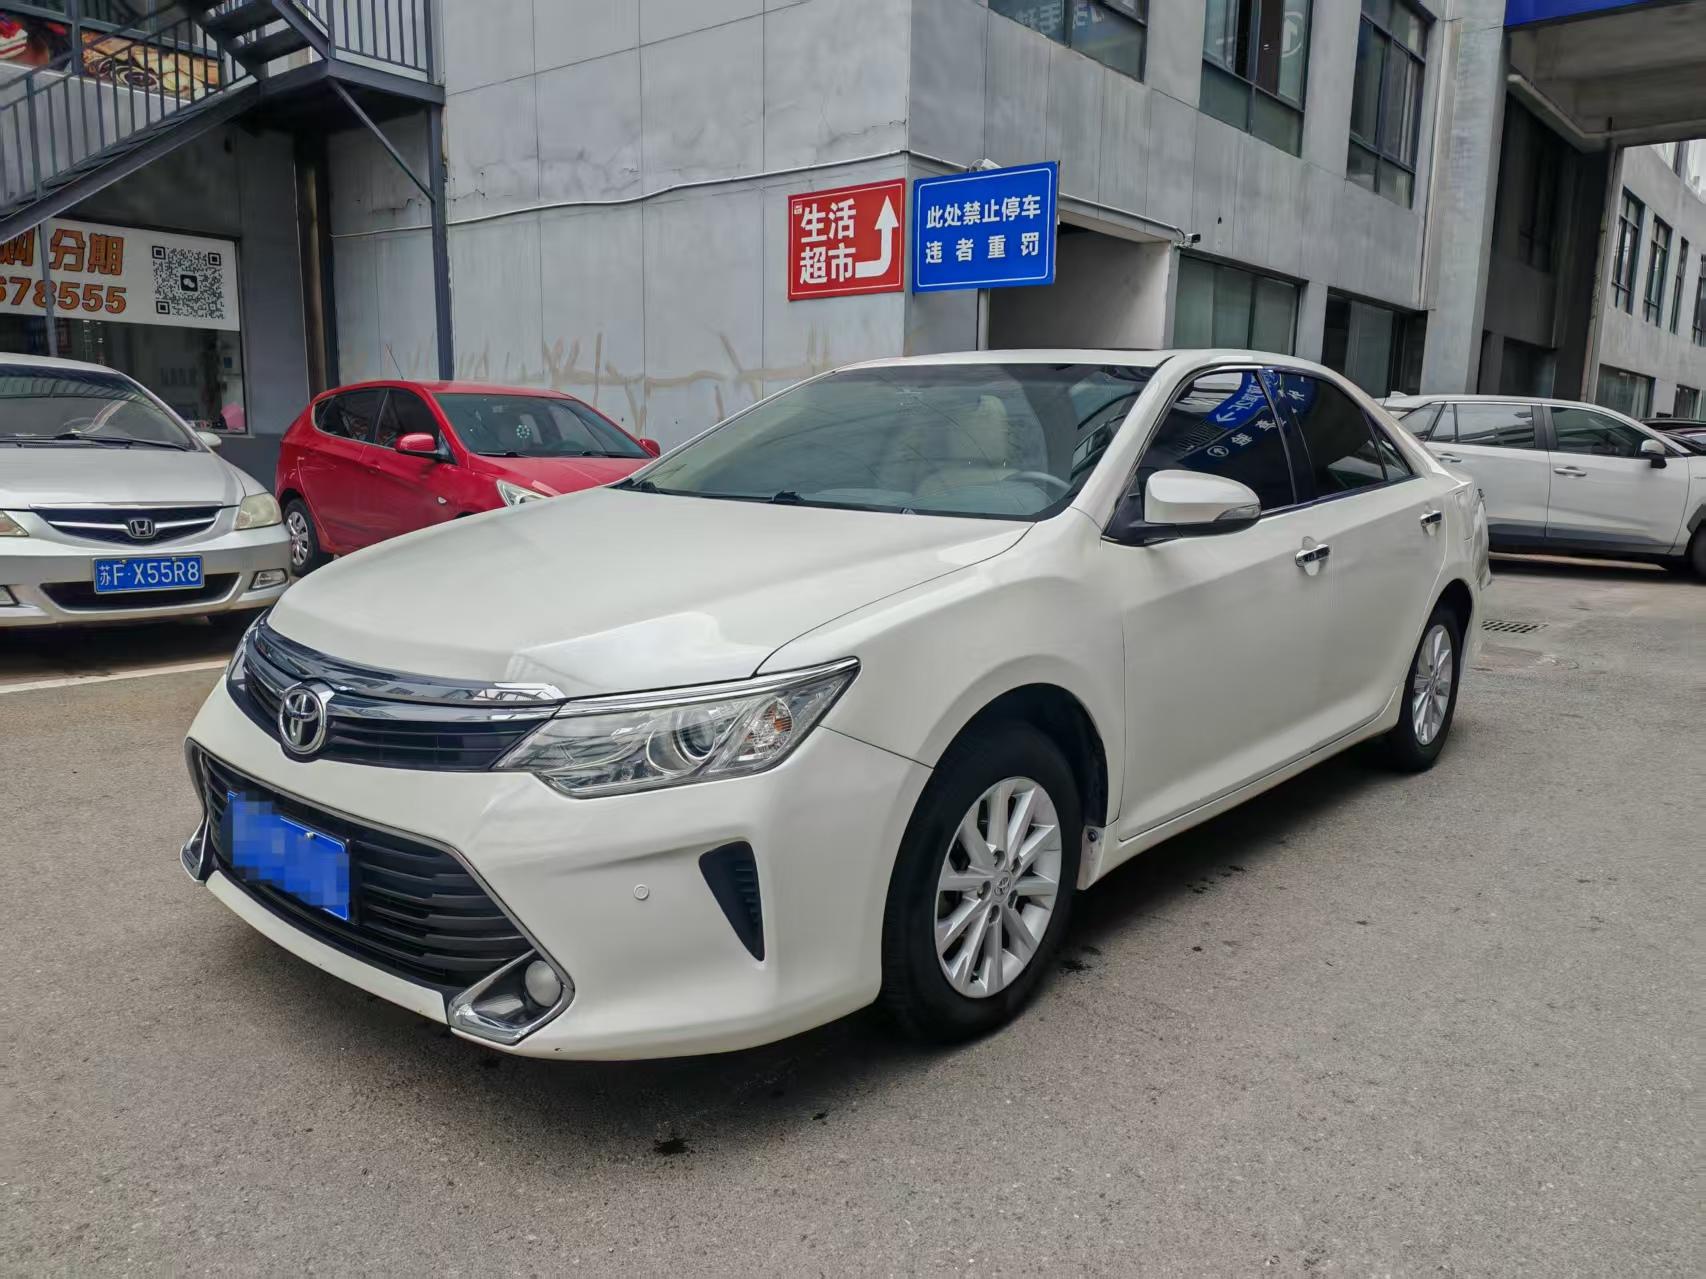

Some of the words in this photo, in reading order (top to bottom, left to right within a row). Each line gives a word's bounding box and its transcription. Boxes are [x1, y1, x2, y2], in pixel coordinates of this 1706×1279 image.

[801, 198, 856, 243] 生活
[926, 195, 1041, 229] 此处禁止停车
[50, 228, 125, 276] 分期
[800, 244, 857, 285] 超市
[926, 232, 1039, 264] 违者重罚
[0, 275, 127, 314] 78555
